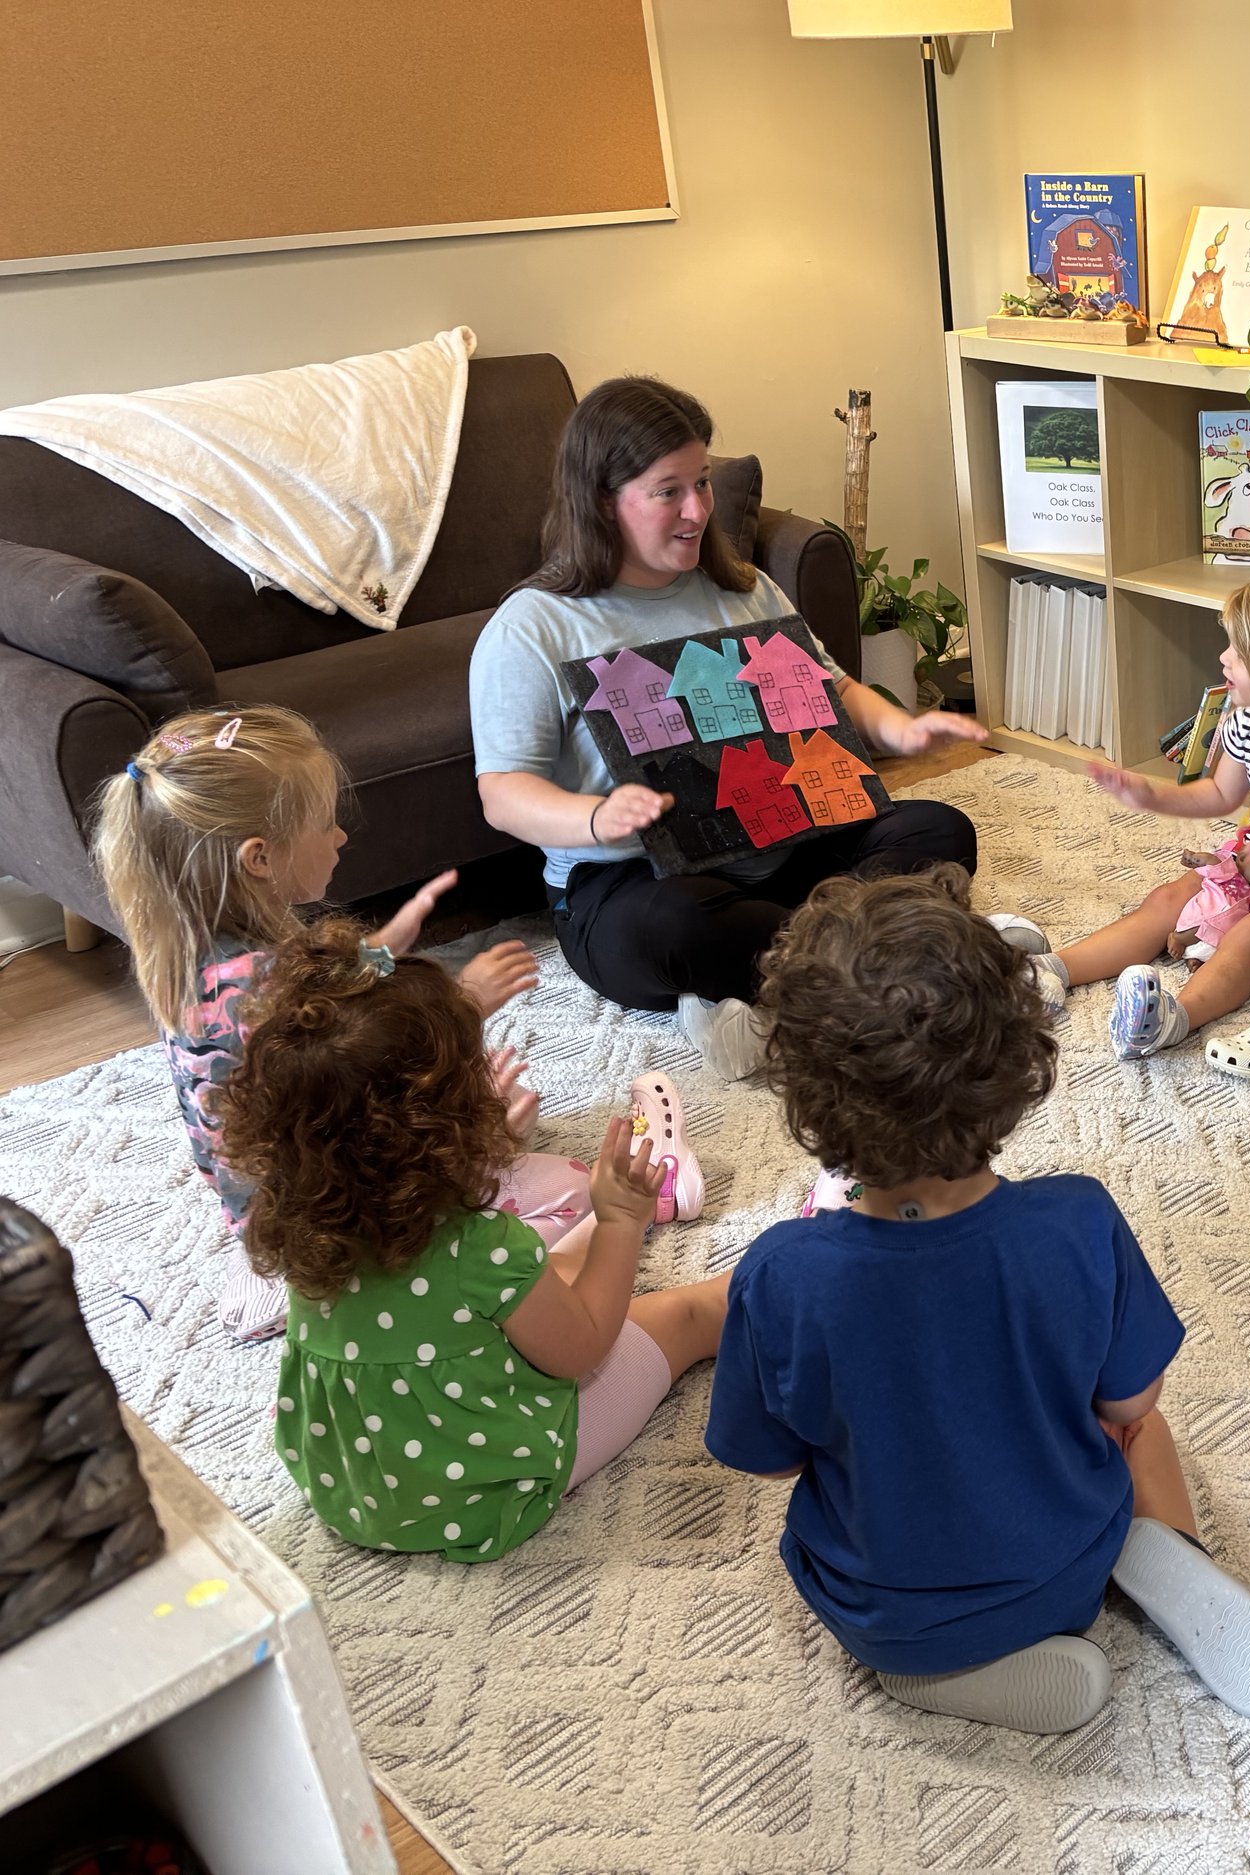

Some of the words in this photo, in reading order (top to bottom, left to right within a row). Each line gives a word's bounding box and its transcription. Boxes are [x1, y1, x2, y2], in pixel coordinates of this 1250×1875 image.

[1040, 181, 1073, 191] Inside
[1075, 183, 1082, 191] a
[1084, 181, 1109, 192] Barn
[1041, 191, 1052, 201] in
[1054, 192, 1071, 202] the
[1073, 192, 1113, 204] Country
[1205, 423, 1239, 438] Click,
[1048, 482, 1068, 491] Oak
[1050, 497, 1069, 506] Oak
[1072, 498, 1095, 508] Class
[1032, 512, 1053, 521] Who
[1055, 513, 1069, 521] Do
[1071, 513, 1088, 522] You
